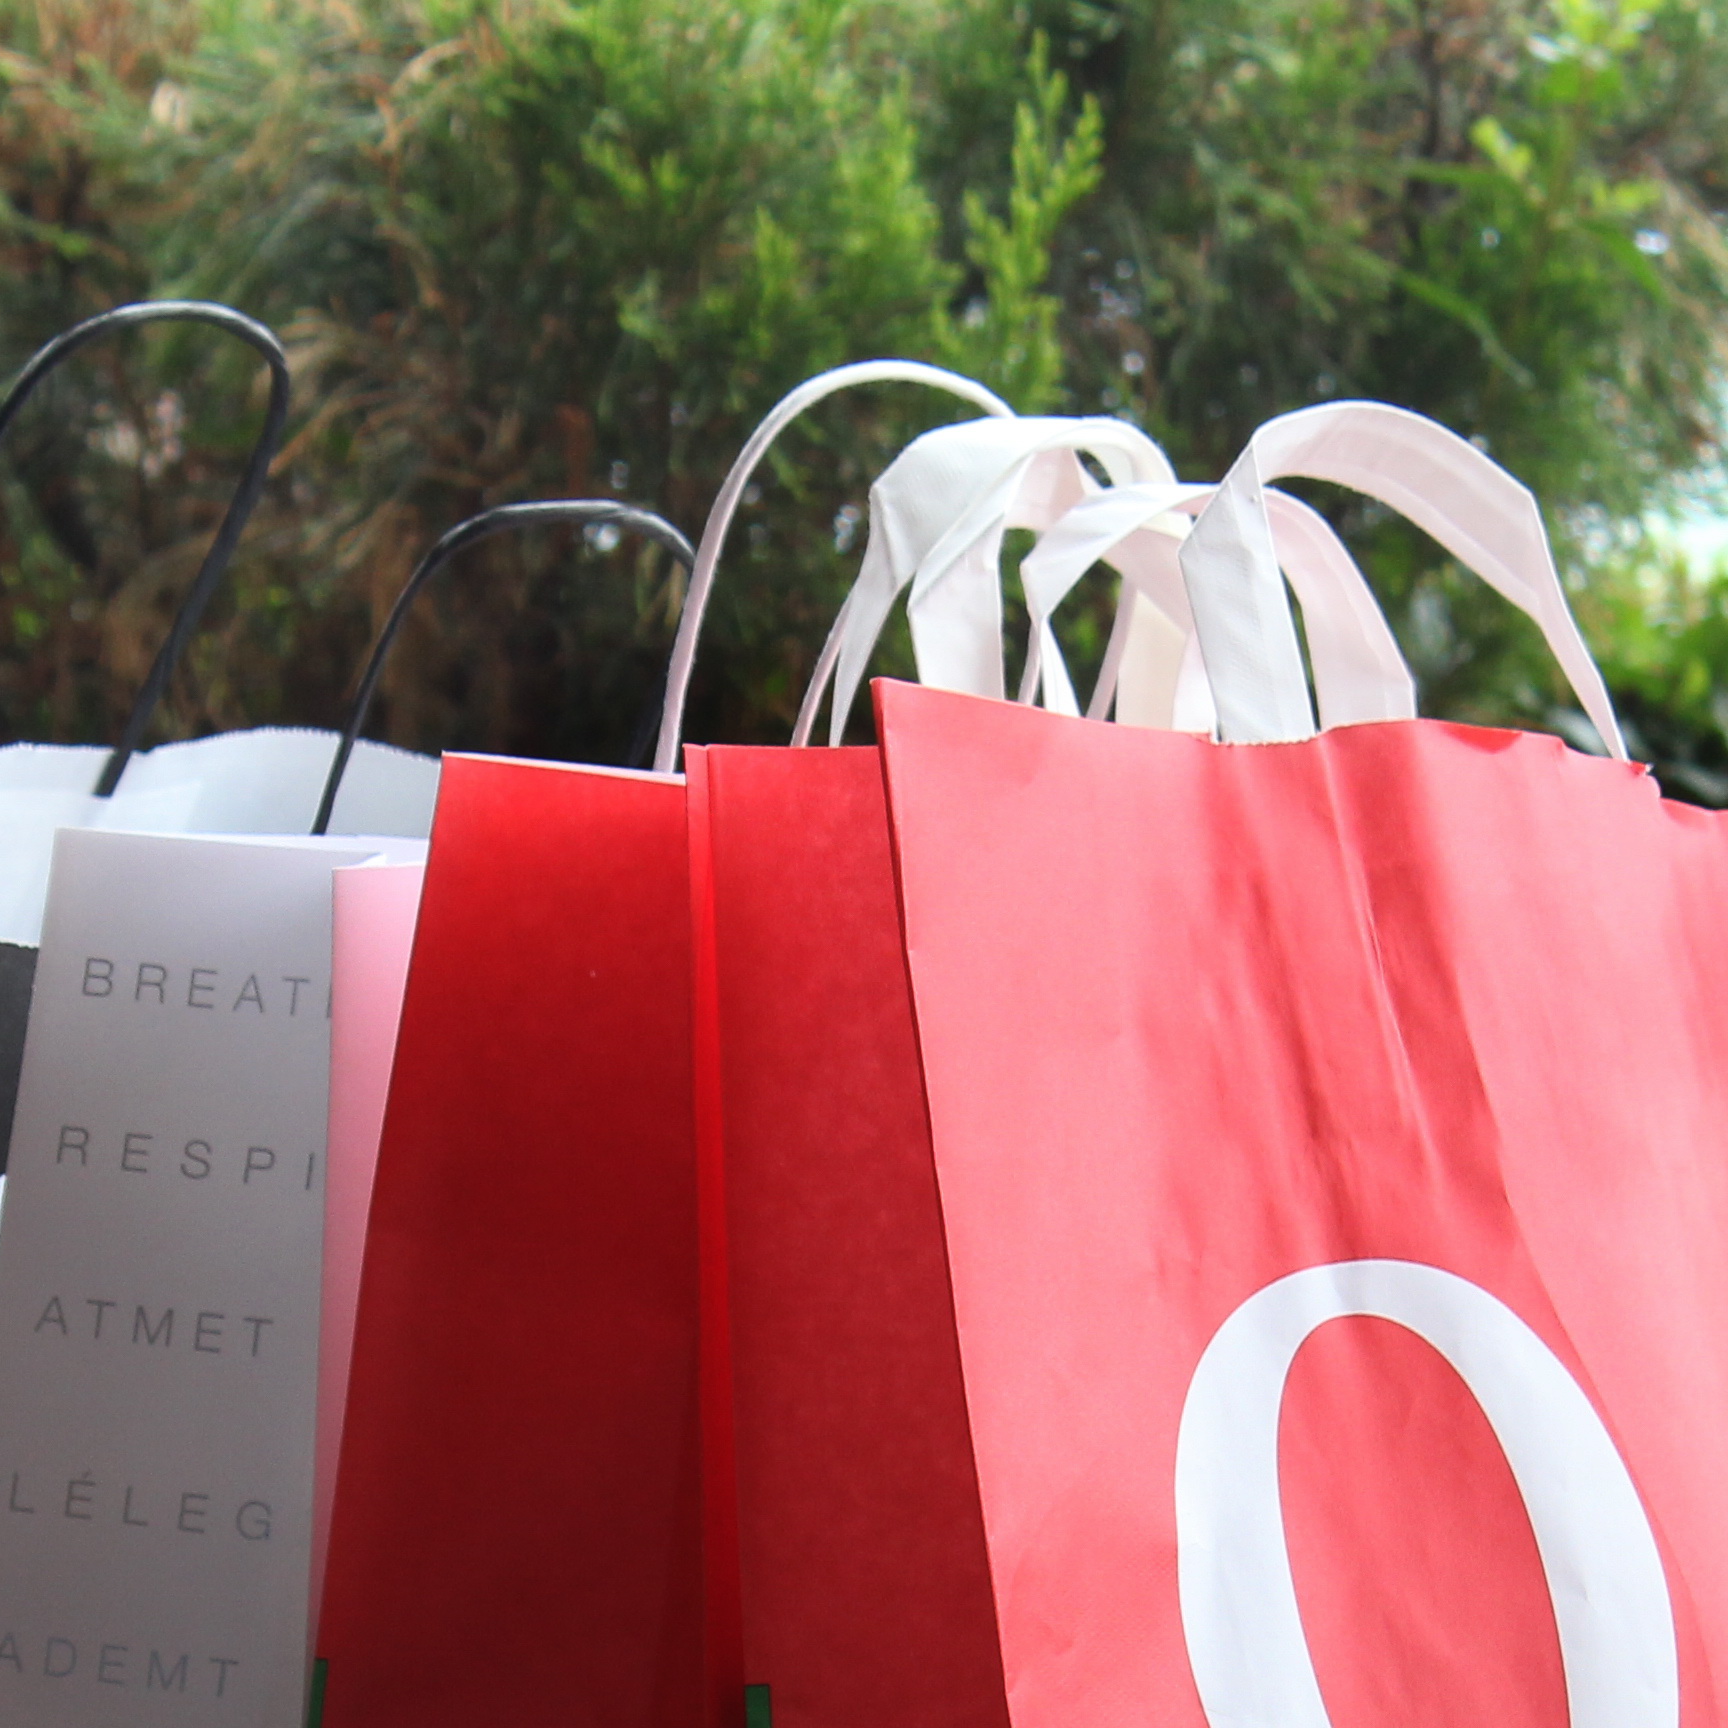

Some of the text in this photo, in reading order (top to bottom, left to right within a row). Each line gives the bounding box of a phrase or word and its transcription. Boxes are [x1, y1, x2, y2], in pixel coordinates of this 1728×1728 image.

[81, 956, 332, 1019] BREAT
[55, 1124, 316, 1191] RESPI
[34, 1295, 276, 1358] ATMET
[8, 1470, 274, 1541] LÉLEG
